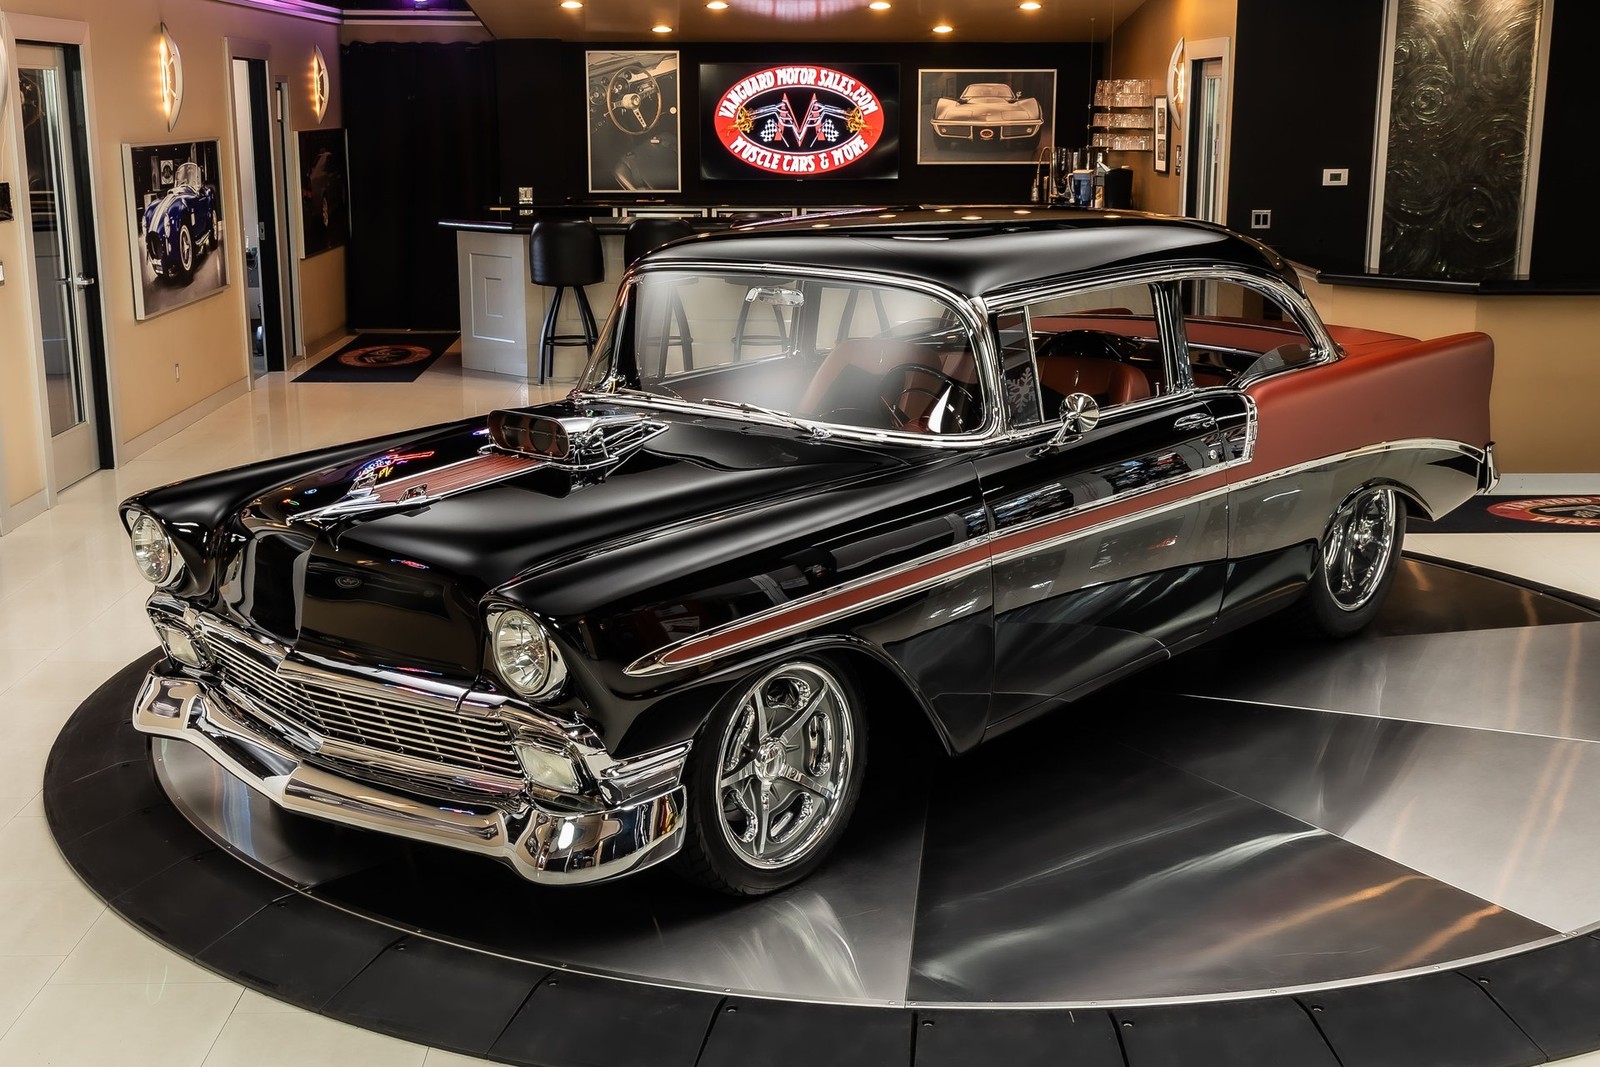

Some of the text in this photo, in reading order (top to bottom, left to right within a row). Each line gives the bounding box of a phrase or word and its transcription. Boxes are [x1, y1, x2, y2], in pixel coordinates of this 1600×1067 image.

[718, 67, 879, 118] VANGUARD MOTOR SALES.COM
[729, 134, 869, 172] MUSCLE CARS & MORE
